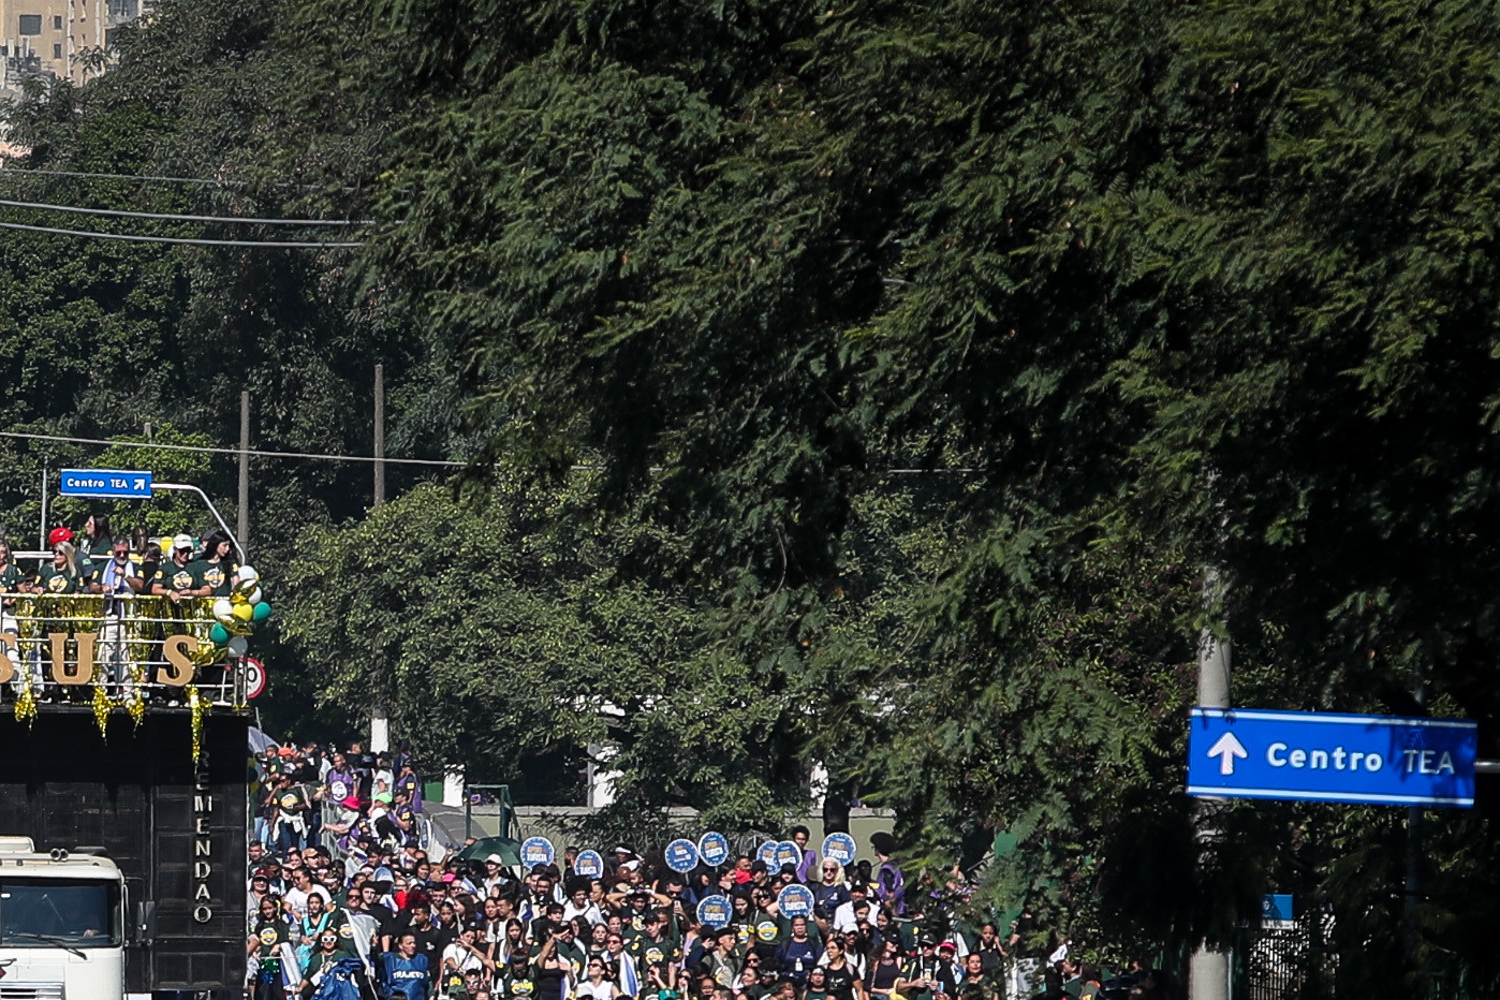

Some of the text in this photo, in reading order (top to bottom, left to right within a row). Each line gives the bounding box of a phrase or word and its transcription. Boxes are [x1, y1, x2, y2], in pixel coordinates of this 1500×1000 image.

[67, 478, 128, 489] Centro TEA
[1267, 743, 1456, 775] Centro TEA
[392, 969, 425, 980] TRAJETO
